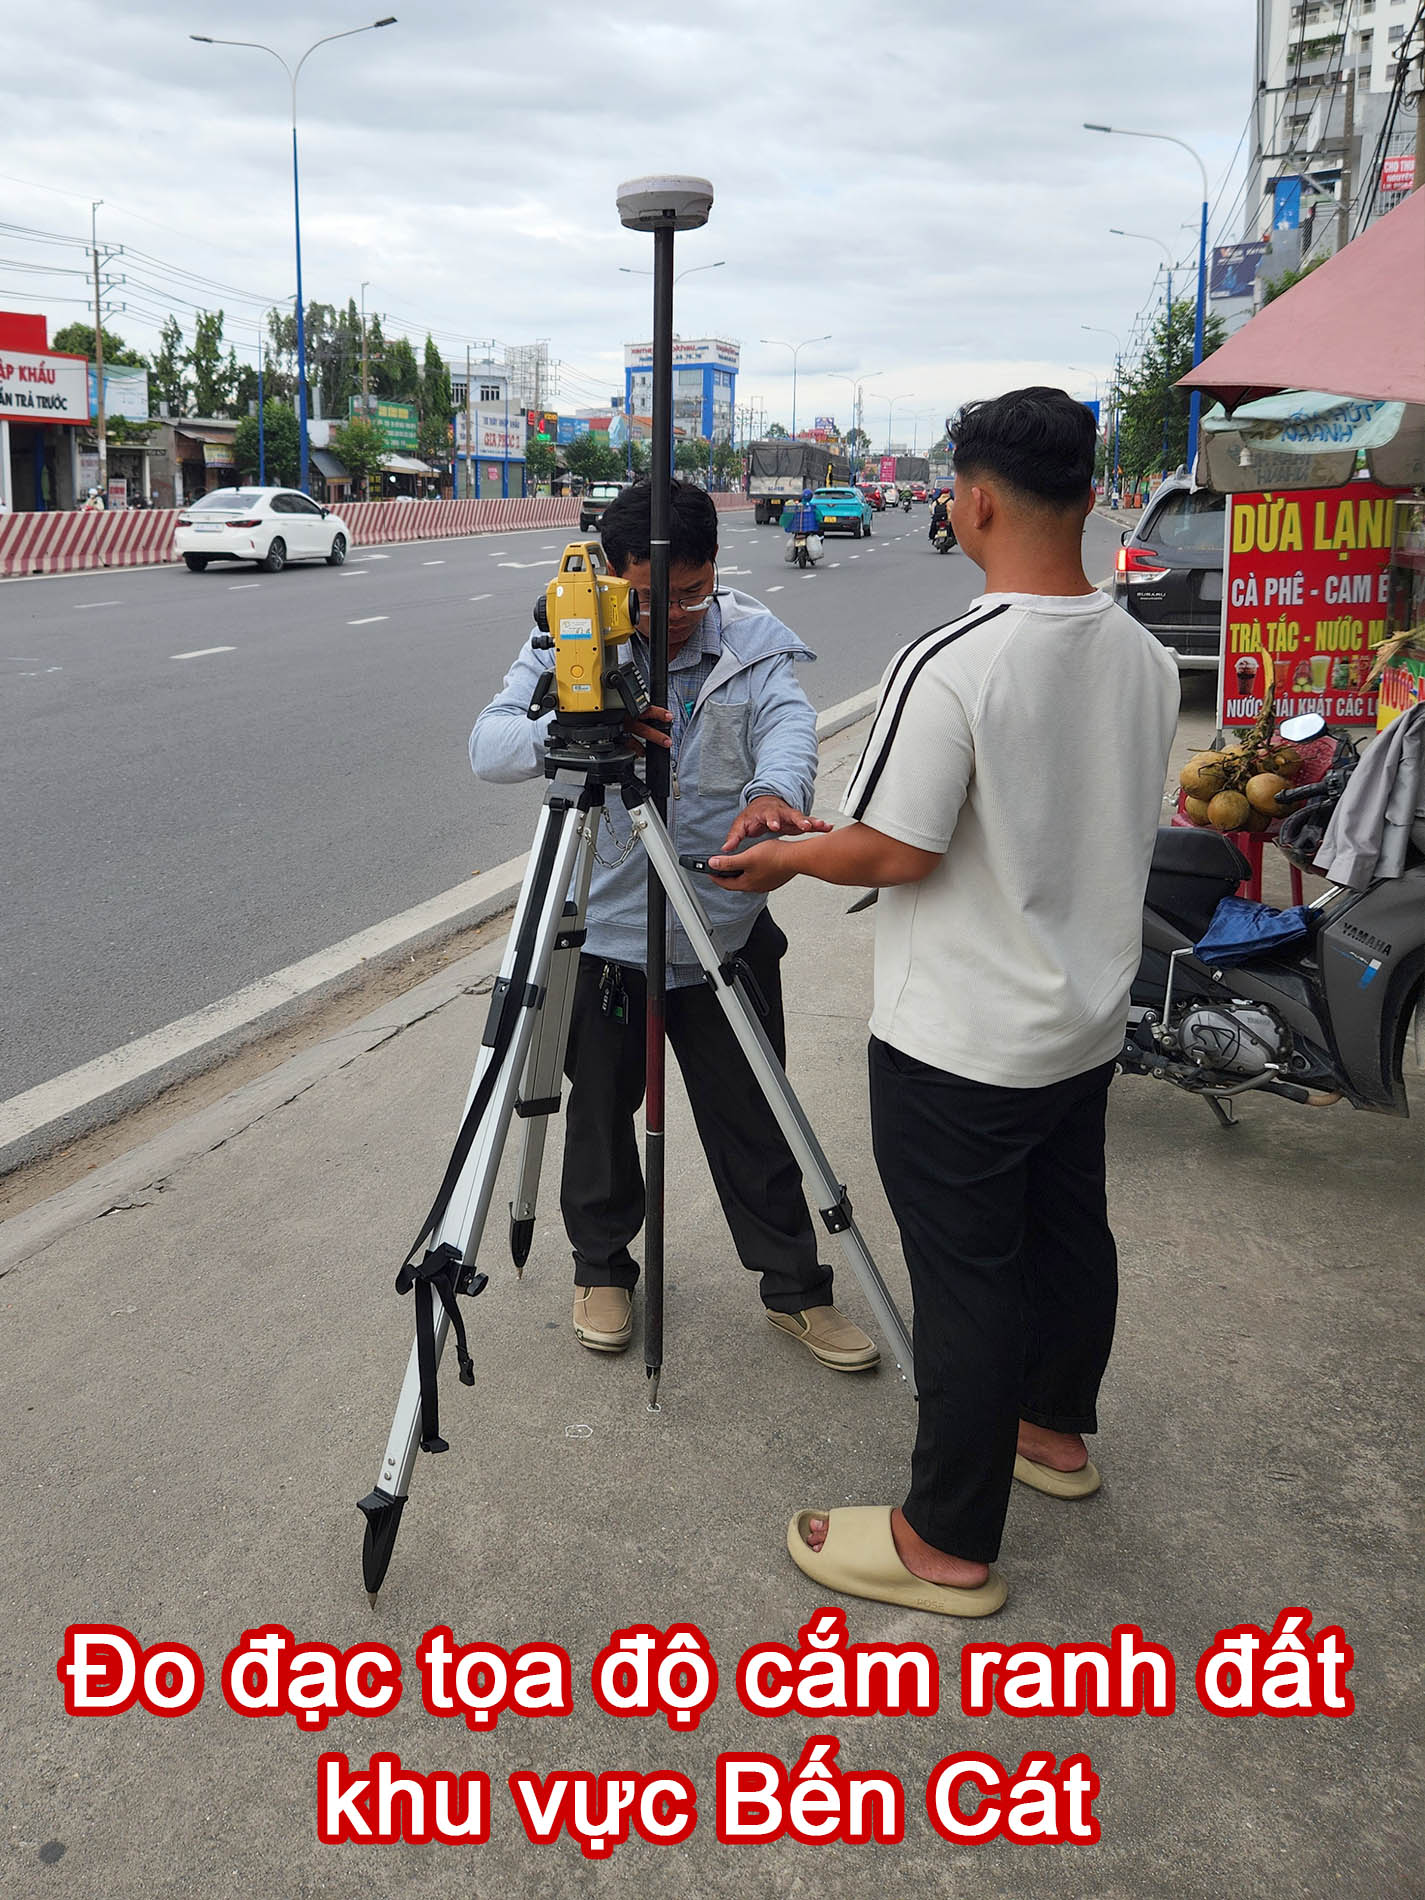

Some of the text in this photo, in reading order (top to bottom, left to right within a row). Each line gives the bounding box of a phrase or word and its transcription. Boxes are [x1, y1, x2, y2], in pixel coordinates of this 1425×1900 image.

[1232, 493, 1304, 554] DỪA
[1231, 572, 1259, 607] CÀ
[1264, 570, 1305, 606] PHÊ
[1324, 574, 1372, 605] CAM
[1377, 569, 1390, 604] É
[1229, 618, 1263, 653] TRÀ
[1267, 613, 1300, 653] TẮC
[1315, 616, 1363, 652] NƯỚC
[1367, 618, 1386, 650] M
[1273, 692, 1294, 717] IẢI
[1297, 693, 1333, 717] KHÁT
[1335, 693, 1364, 717] CÁC
[1367, 697, 1378, 717] L
[1342, 922, 1393, 957] YAMAHA
